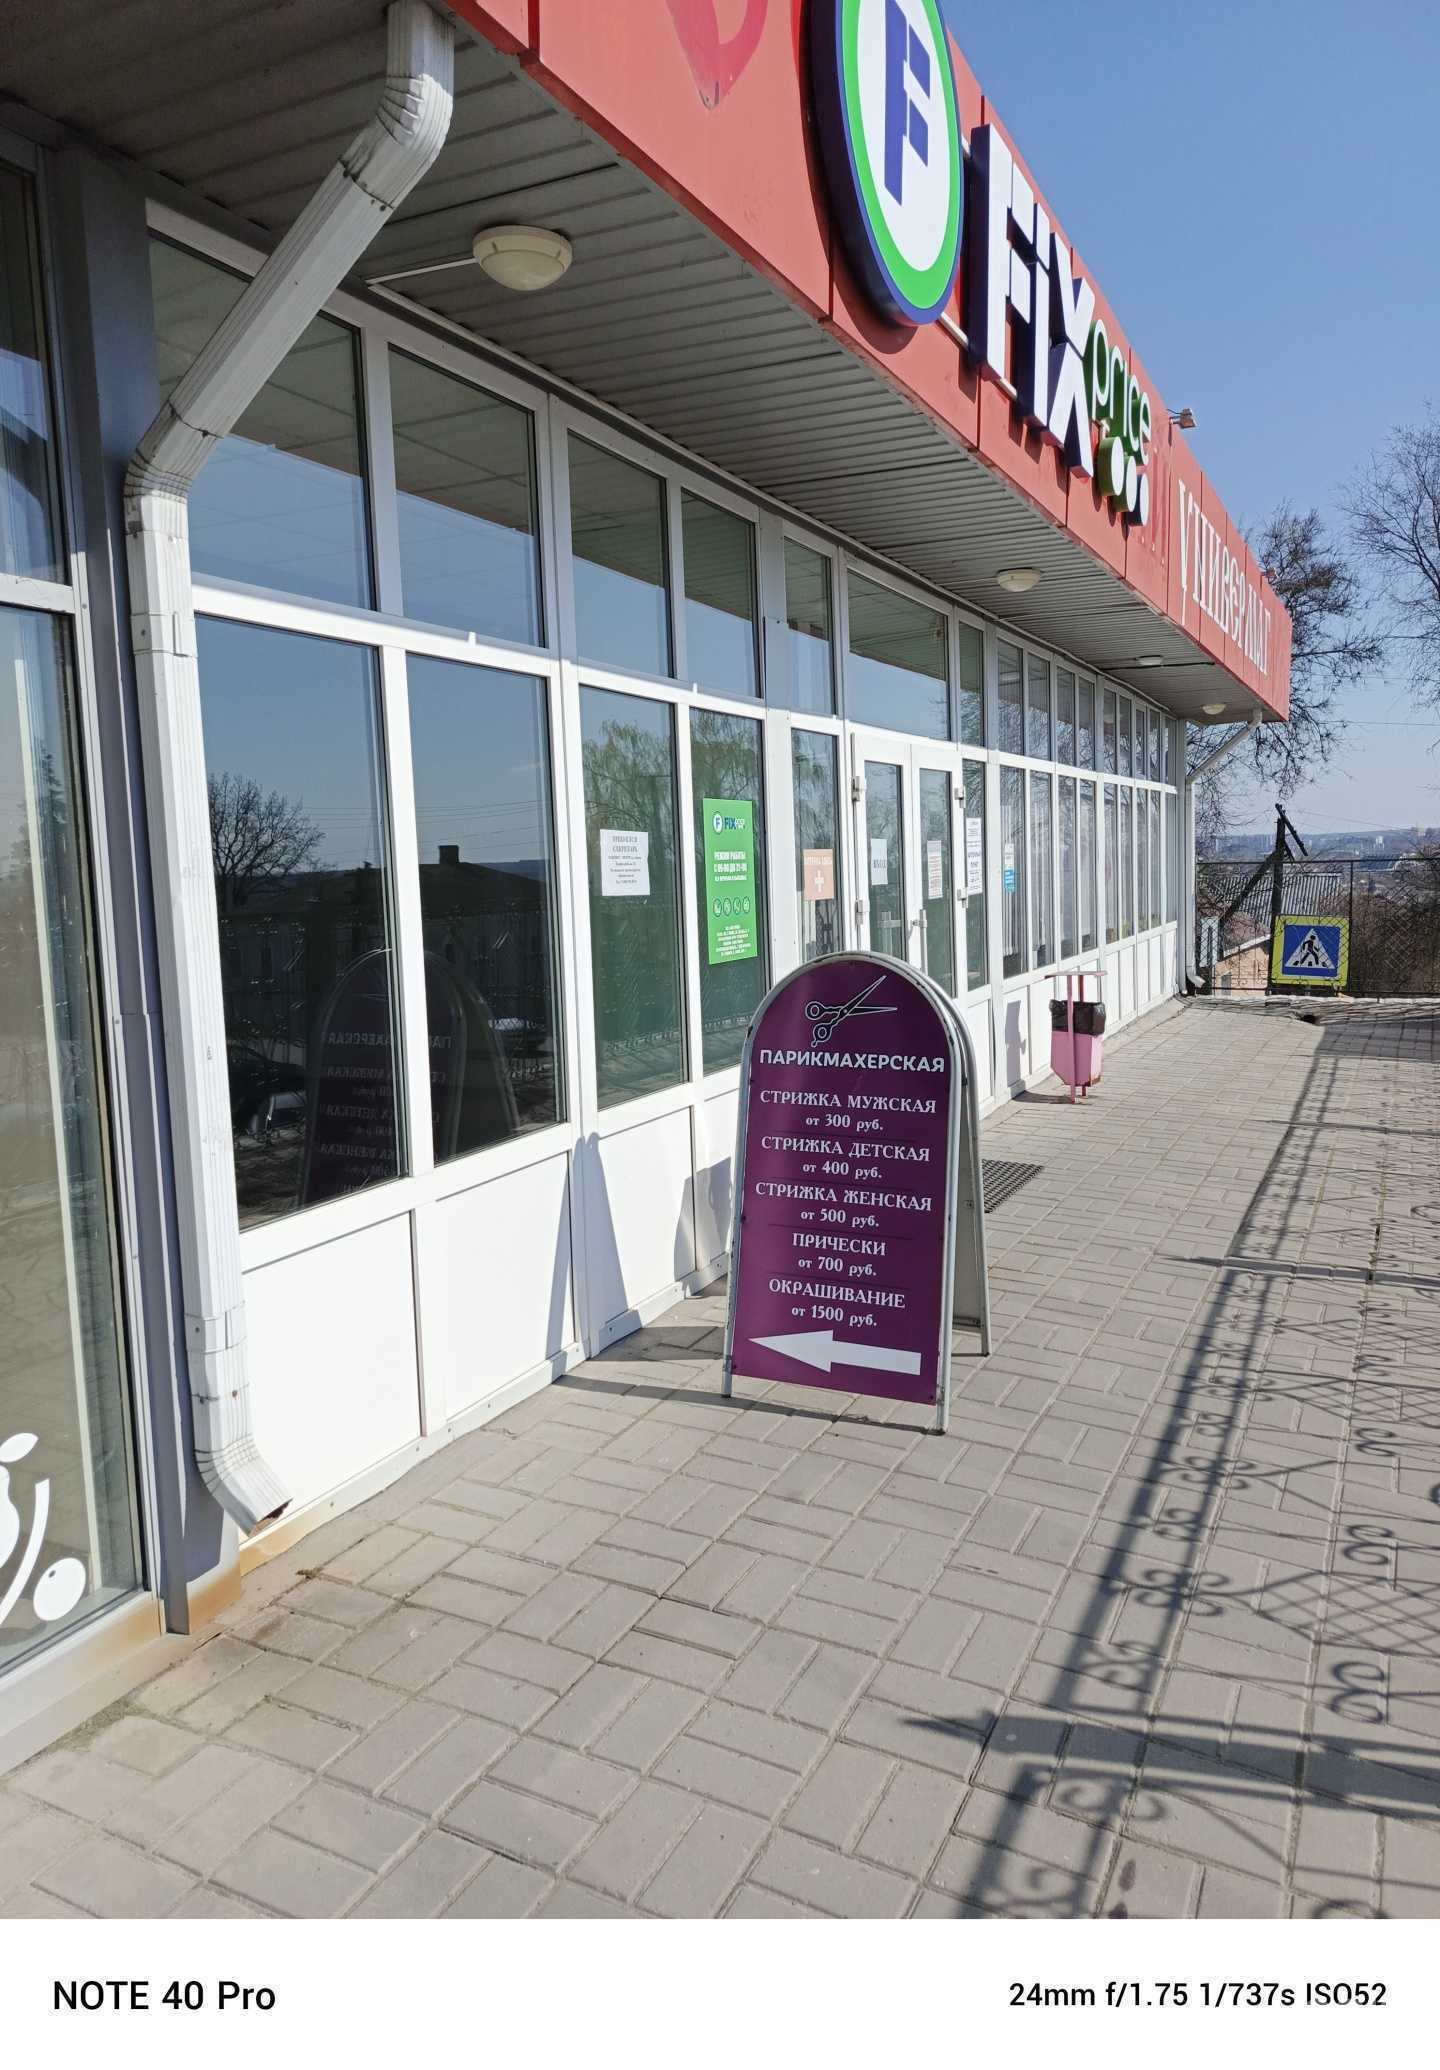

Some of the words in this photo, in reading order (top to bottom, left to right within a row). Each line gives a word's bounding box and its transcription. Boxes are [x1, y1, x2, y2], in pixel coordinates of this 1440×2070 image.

[1091, 318, 1152, 466] price
[1178, 479, 1272, 677] УНИВЕРМАГ
[759, 1049, 945, 1073] ПАРИКМАХЕРСКАЯ
[760, 1090, 842, 1107] СТРИЖКА
[847, 1094, 936, 1114] МУЖСКАЯ
[805, 1117, 820, 1126] от
[825, 1113, 851, 1128] 300
[856, 1118, 884, 1133] руб.
[761, 1136, 843, 1155] СТРИЖКА
[848, 1142, 930, 1162] ДЕТСКАЯ
[802, 1164, 817, 1173] от
[821, 1160, 850, 1176] 400
[854, 1166, 882, 1180] руб.
[755, 1182, 838, 1202] СТРИЖКА
[841, 1189, 932, 1211] ЖЕНСКАЯ
[800, 1211, 815, 1220] от
[820, 1208, 846, 1224] 500
[851, 1215, 879, 1229] руб.
[792, 1232, 886, 1257] ПРИЧЕСКИ
[798, 1259, 813, 1268] от
[817, 1256, 844, 1272] 700
[848, 1263, 877, 1278] руб.
[768, 1278, 906, 1309] ОКРАШИВАНИЕ
[791, 1307, 806, 1317] от
[811, 1304, 844, 1322] 1500
[849, 1313, 877, 1328] руб.
